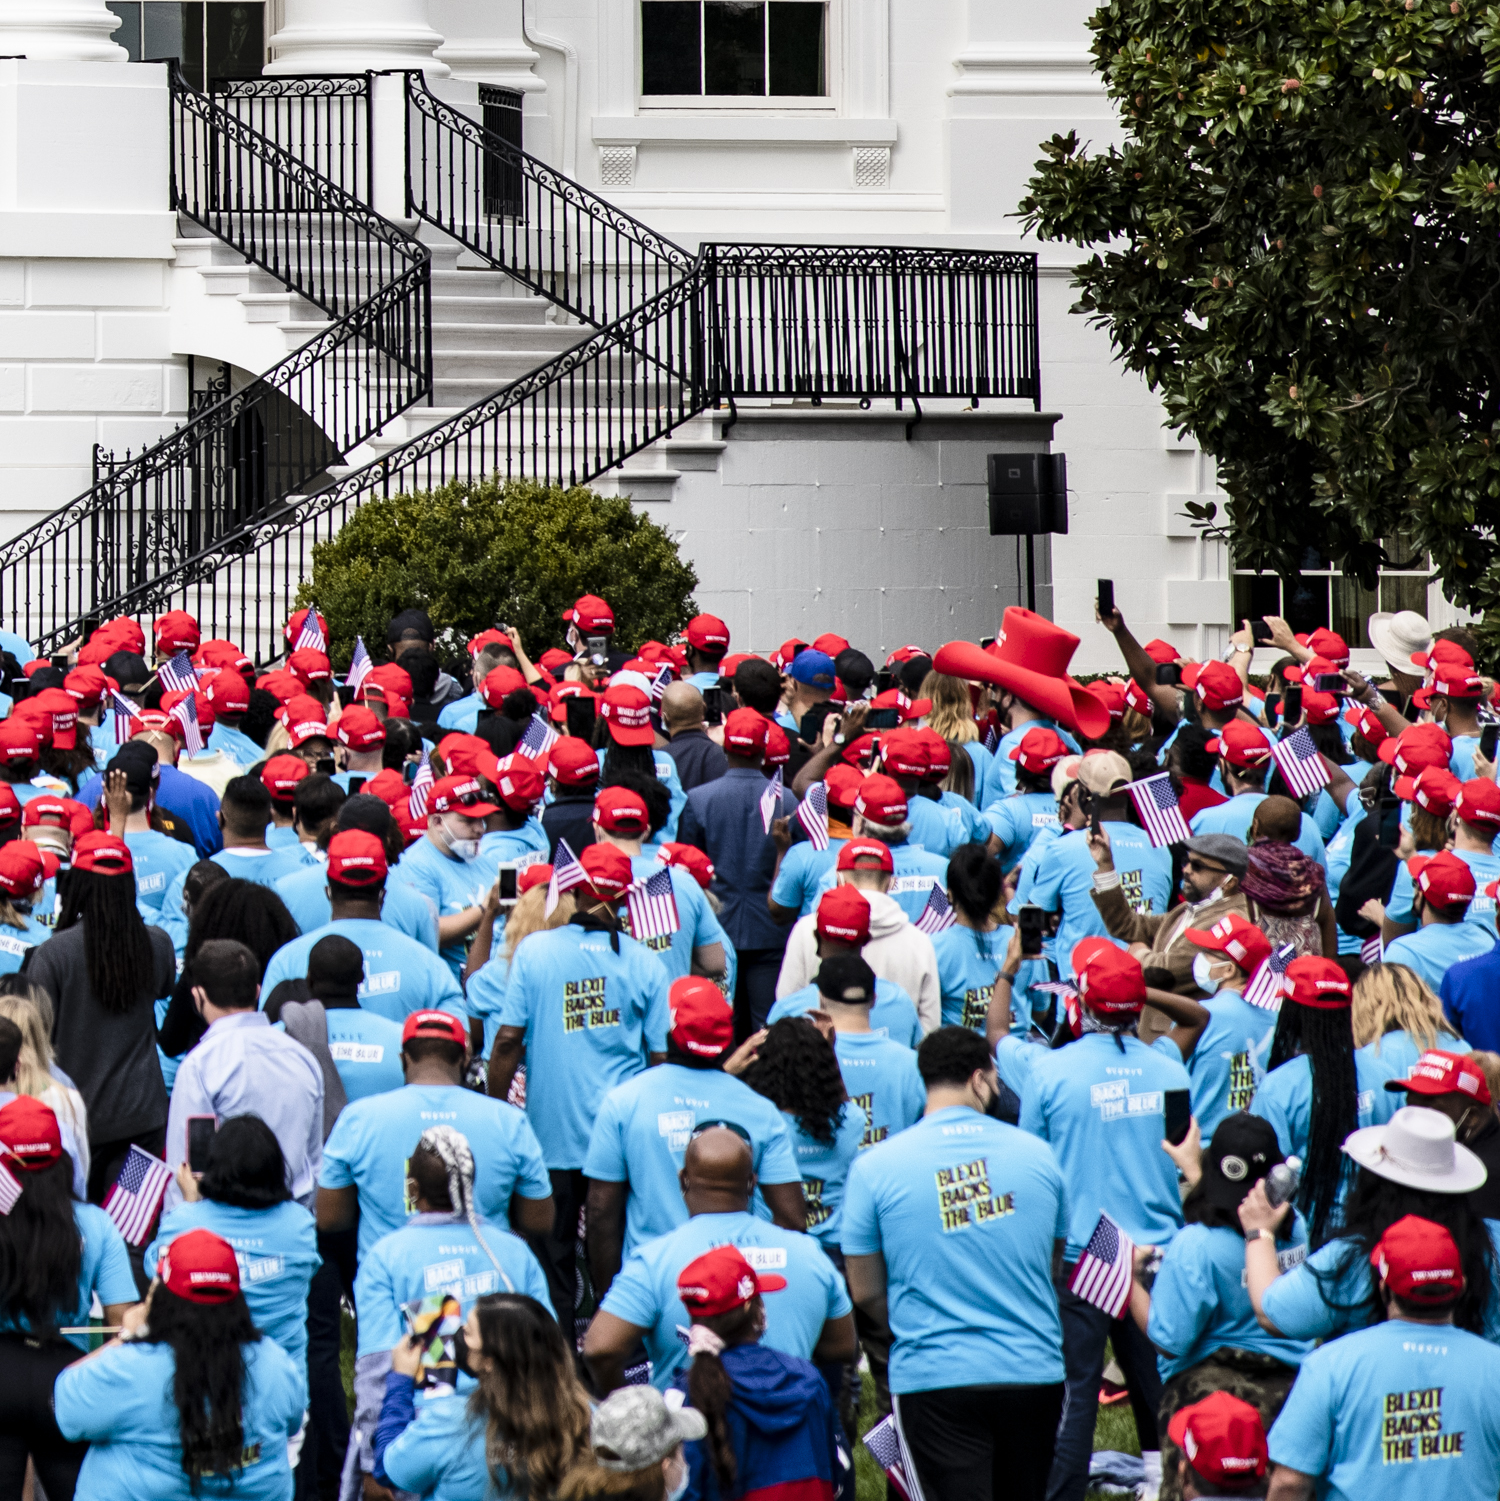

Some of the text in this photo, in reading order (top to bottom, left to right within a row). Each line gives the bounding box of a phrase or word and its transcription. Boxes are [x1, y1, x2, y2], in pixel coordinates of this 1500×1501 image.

[565, 977, 606, 997] BLEXIT
[565, 998, 605, 1014] BACKS
[564, 1010, 620, 1033] THE BLUE
[937, 1158, 988, 1186] BLEXIT
[943, 1184, 991, 1205] BACKS
[943, 1196, 1015, 1231] THE BLUE
[1384, 1389, 1444, 1413] BLEXIT
[1384, 1414, 1442, 1437] BACKS
[1381, 1433, 1464, 1463] THE BLUE
